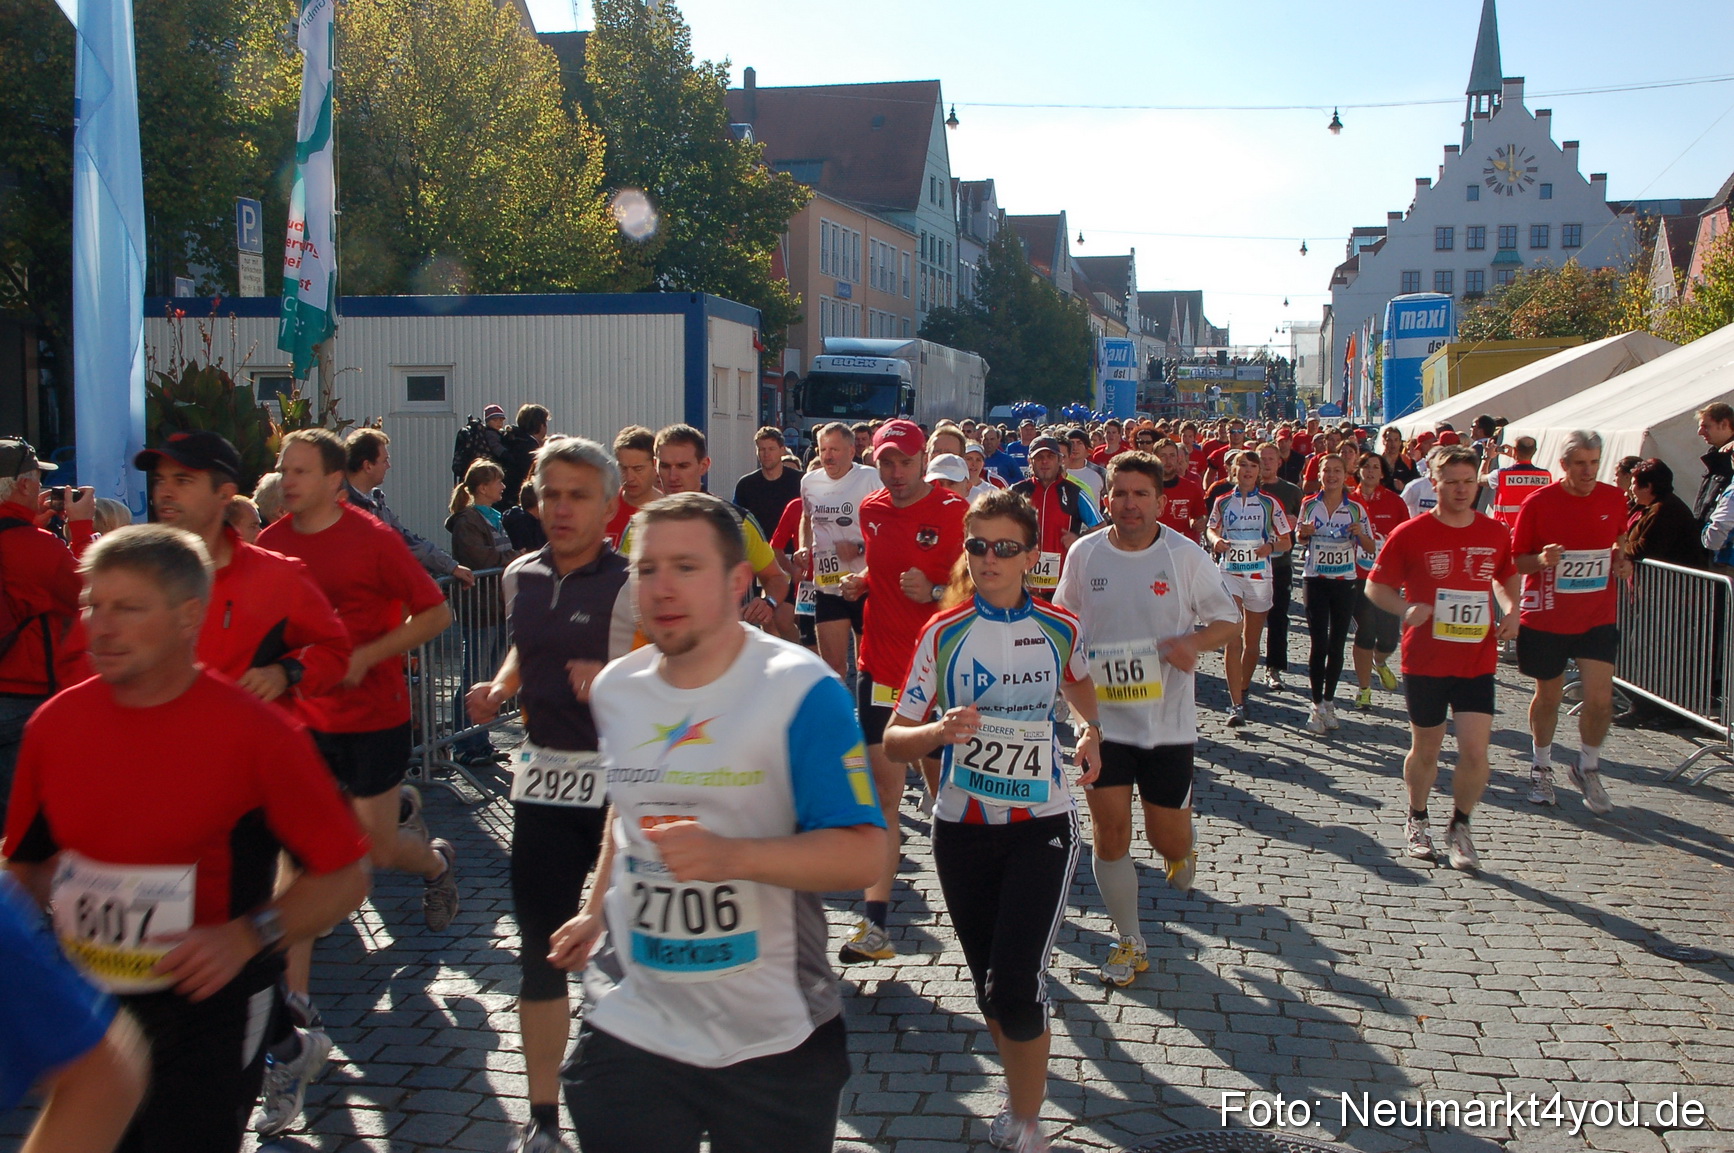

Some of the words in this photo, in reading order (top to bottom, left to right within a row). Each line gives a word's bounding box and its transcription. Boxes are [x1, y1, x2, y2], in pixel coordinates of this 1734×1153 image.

[243, 205, 256, 244] P
[1400, 305, 1447, 331] maxi
[831, 357, 877, 368] BOCK
[1104, 346, 1128, 361] axi
[1113, 368, 1126, 379] dsl
[814, 504, 840, 515] Allianz
[818, 556, 840, 575] 496
[1318, 550, 1350, 565] 2031
[1030, 561, 1050, 576] 04
[1562, 560, 1604, 578] 2271
[1448, 603, 1483, 624] 167
[1002, 670, 1051, 686] PLAST
[1101, 658, 1145, 685] 156
[963, 736, 1042, 777] 2274
[524, 767, 596, 802] 2929
[968, 771, 1031, 798] Monika
[632, 881, 740, 936] 2706
[643, 936, 734, 965] Markus
